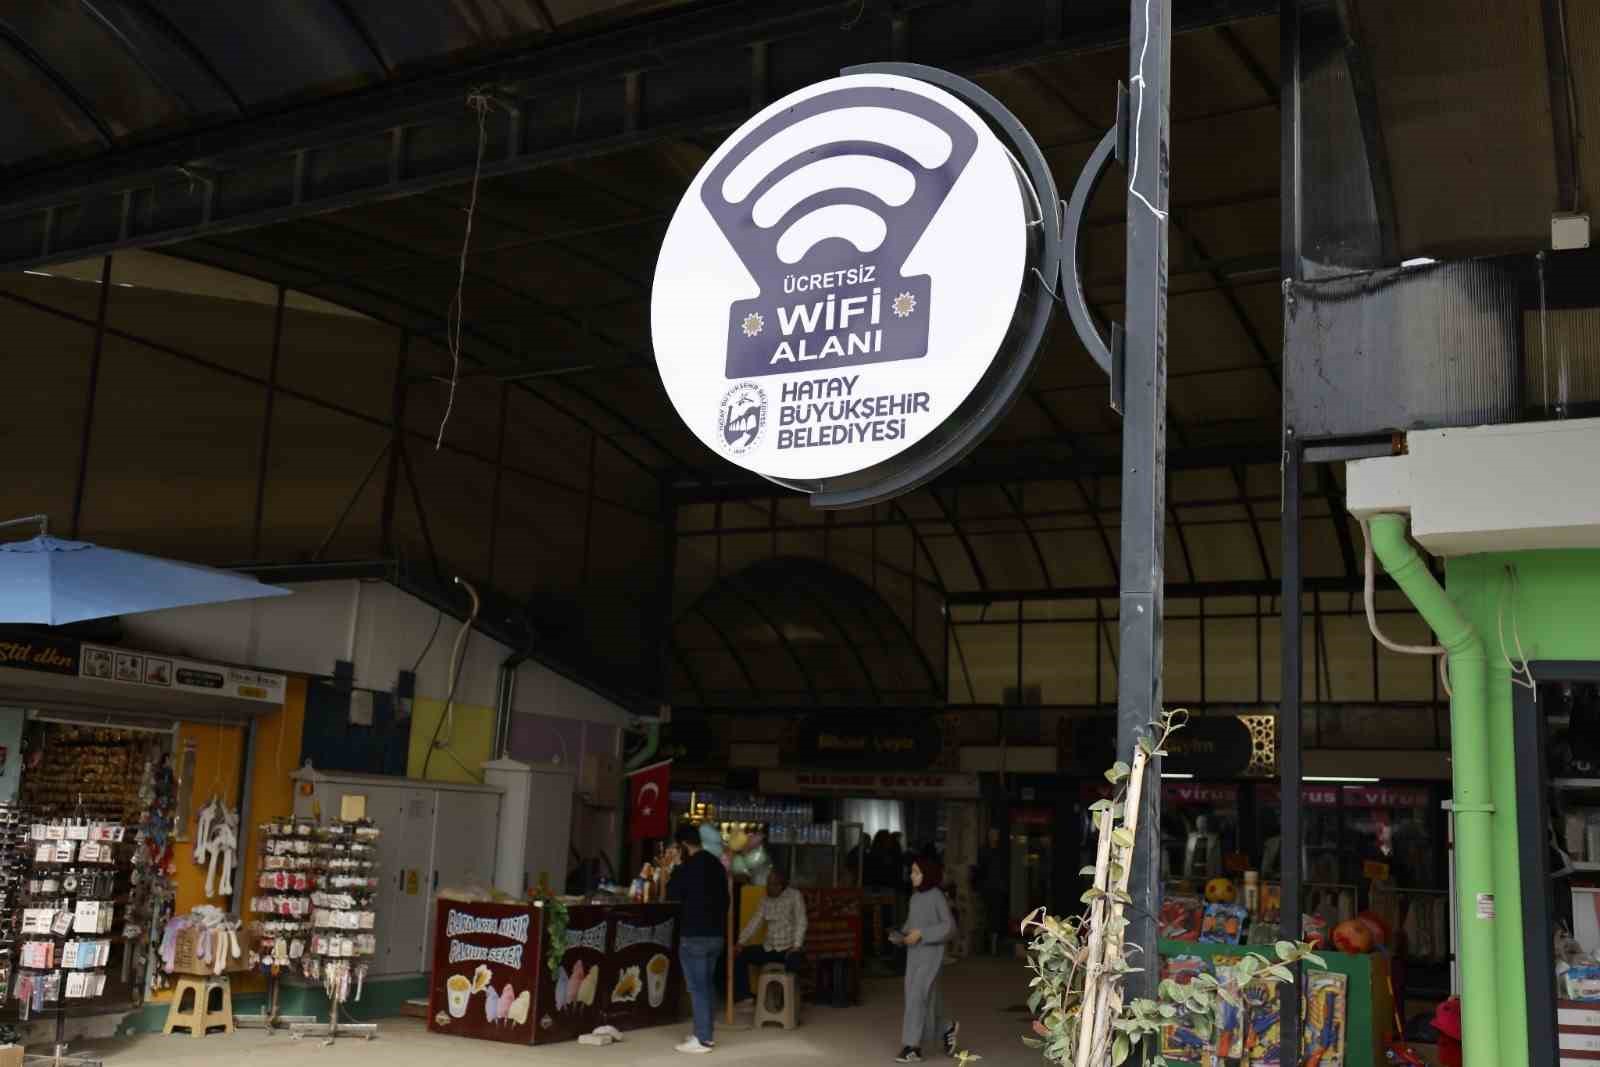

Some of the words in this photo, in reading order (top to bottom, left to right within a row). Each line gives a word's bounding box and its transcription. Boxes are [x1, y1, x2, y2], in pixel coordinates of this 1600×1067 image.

[783, 264, 876, 294] ÜCRETSİZ
[776, 287, 881, 336] WİFİ
[769, 329, 882, 365] ALANI
[780, 374, 860, 402] HATAY
[778, 391, 930, 427] BÜYÜKŞEHİR
[777, 418, 907, 450] BELEDİYESİ
